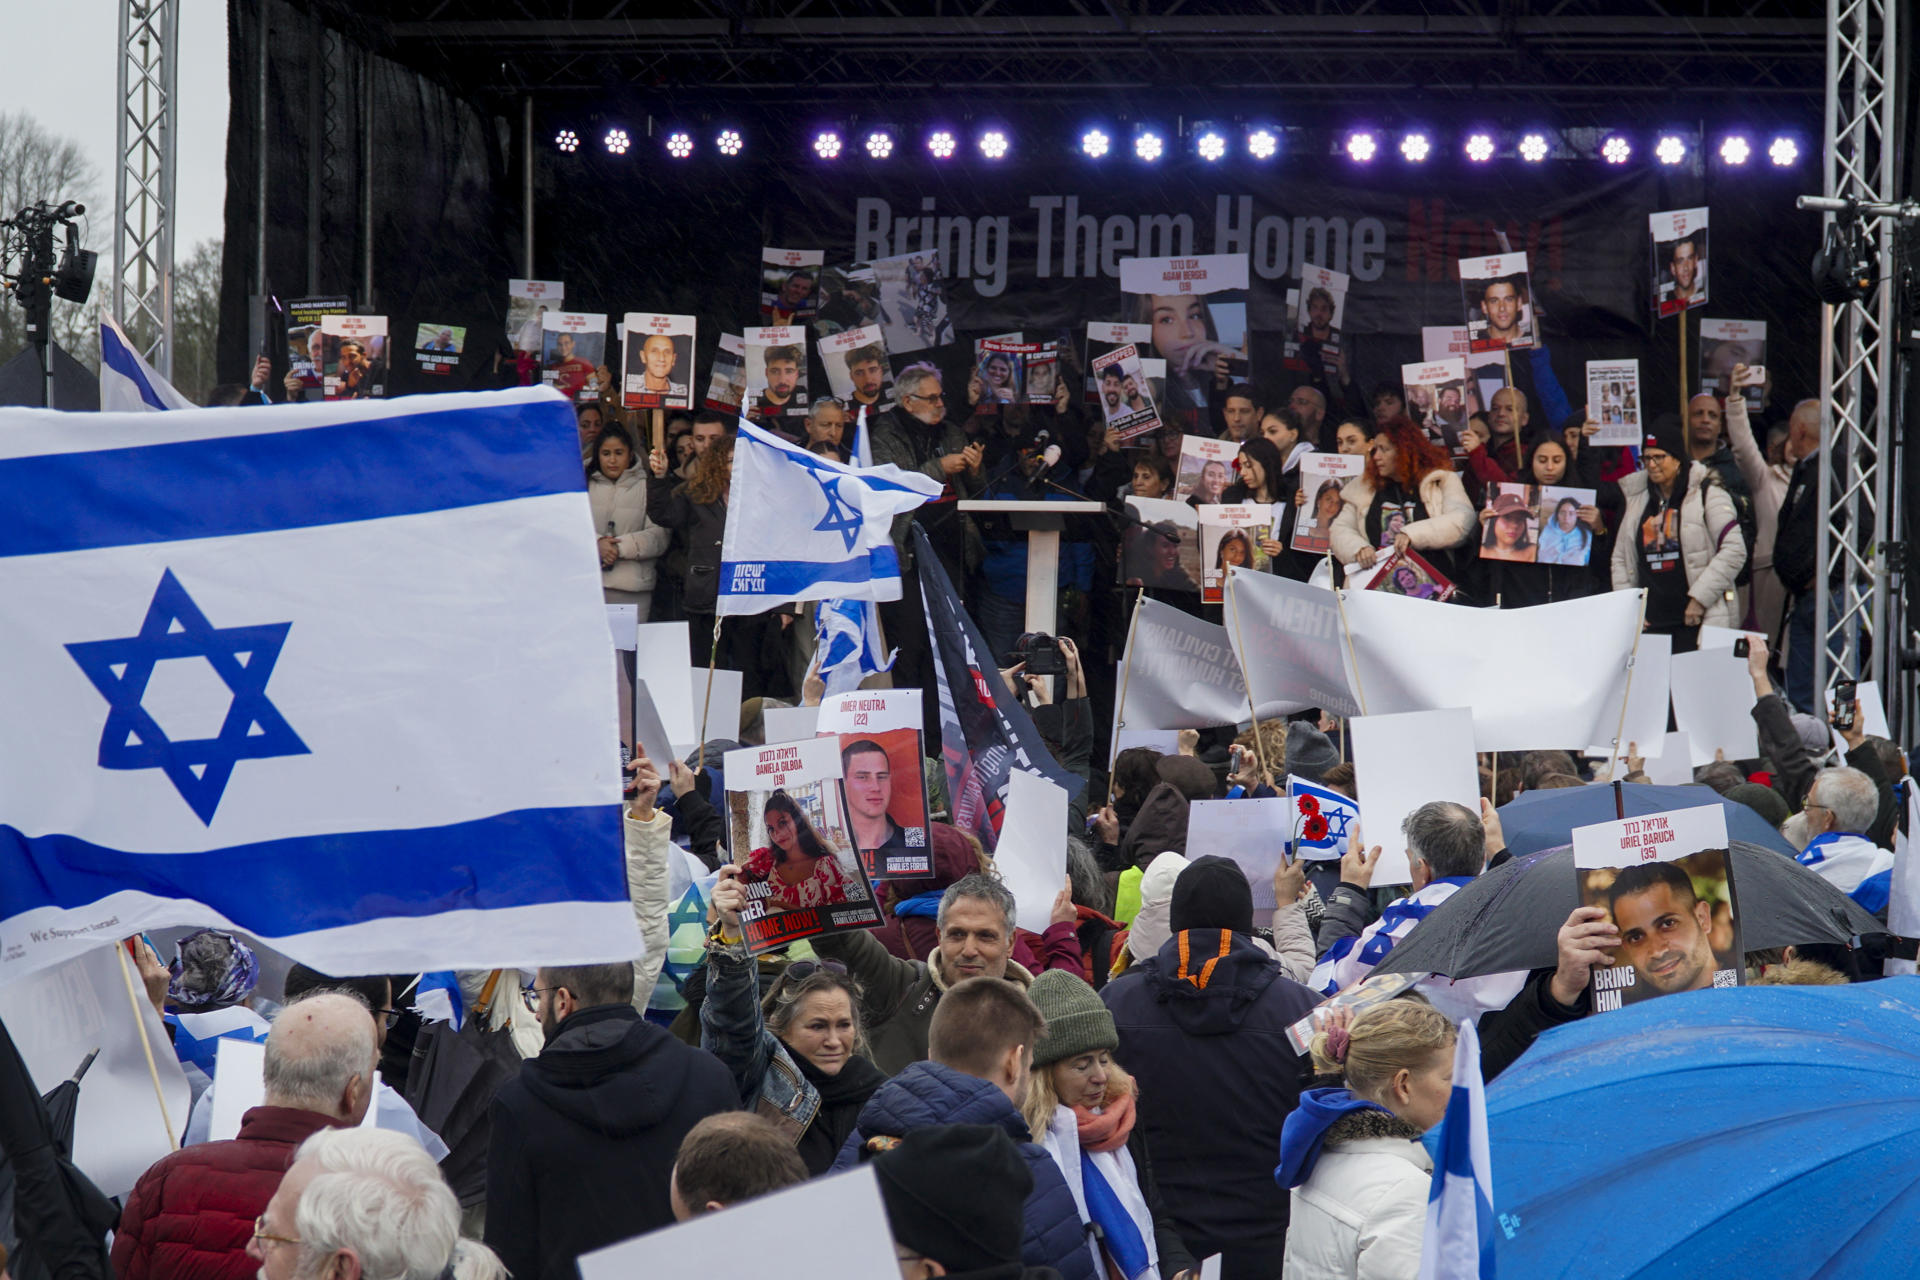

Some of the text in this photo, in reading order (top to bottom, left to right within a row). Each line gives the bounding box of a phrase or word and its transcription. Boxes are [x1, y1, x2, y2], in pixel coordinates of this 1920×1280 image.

[856, 197, 1009, 298] Bring
[1029, 195, 1194, 279] Them
[1215, 195, 1385, 281] Home
[1162, 270, 1207, 281] AGAM BERGER
[1095, 347, 1135, 368] KIDNAPPED
[840, 698, 887, 713] OMER NEUTRA
[854, 713, 868, 726] (22)
[756, 759, 803, 775] DANIELA GILBOA
[773, 773, 786, 787] (19)
[1623, 816, 1669, 836] אוריאל ברוך
[1620, 830, 1675, 849] URIEL BARUCH
[1641, 846, 1657, 861] (35)
[887, 862, 928, 871] FAMILIES FORUM
[744, 881, 773, 900] RING
[745, 908, 821, 943] HOME NOW!
[833, 912, 878, 925] FAMILIES FORUM
[30, 915, 120, 944] We Support Israel
[1594, 965, 1635, 991] BRING
[1596, 989, 1623, 1012] HIM
